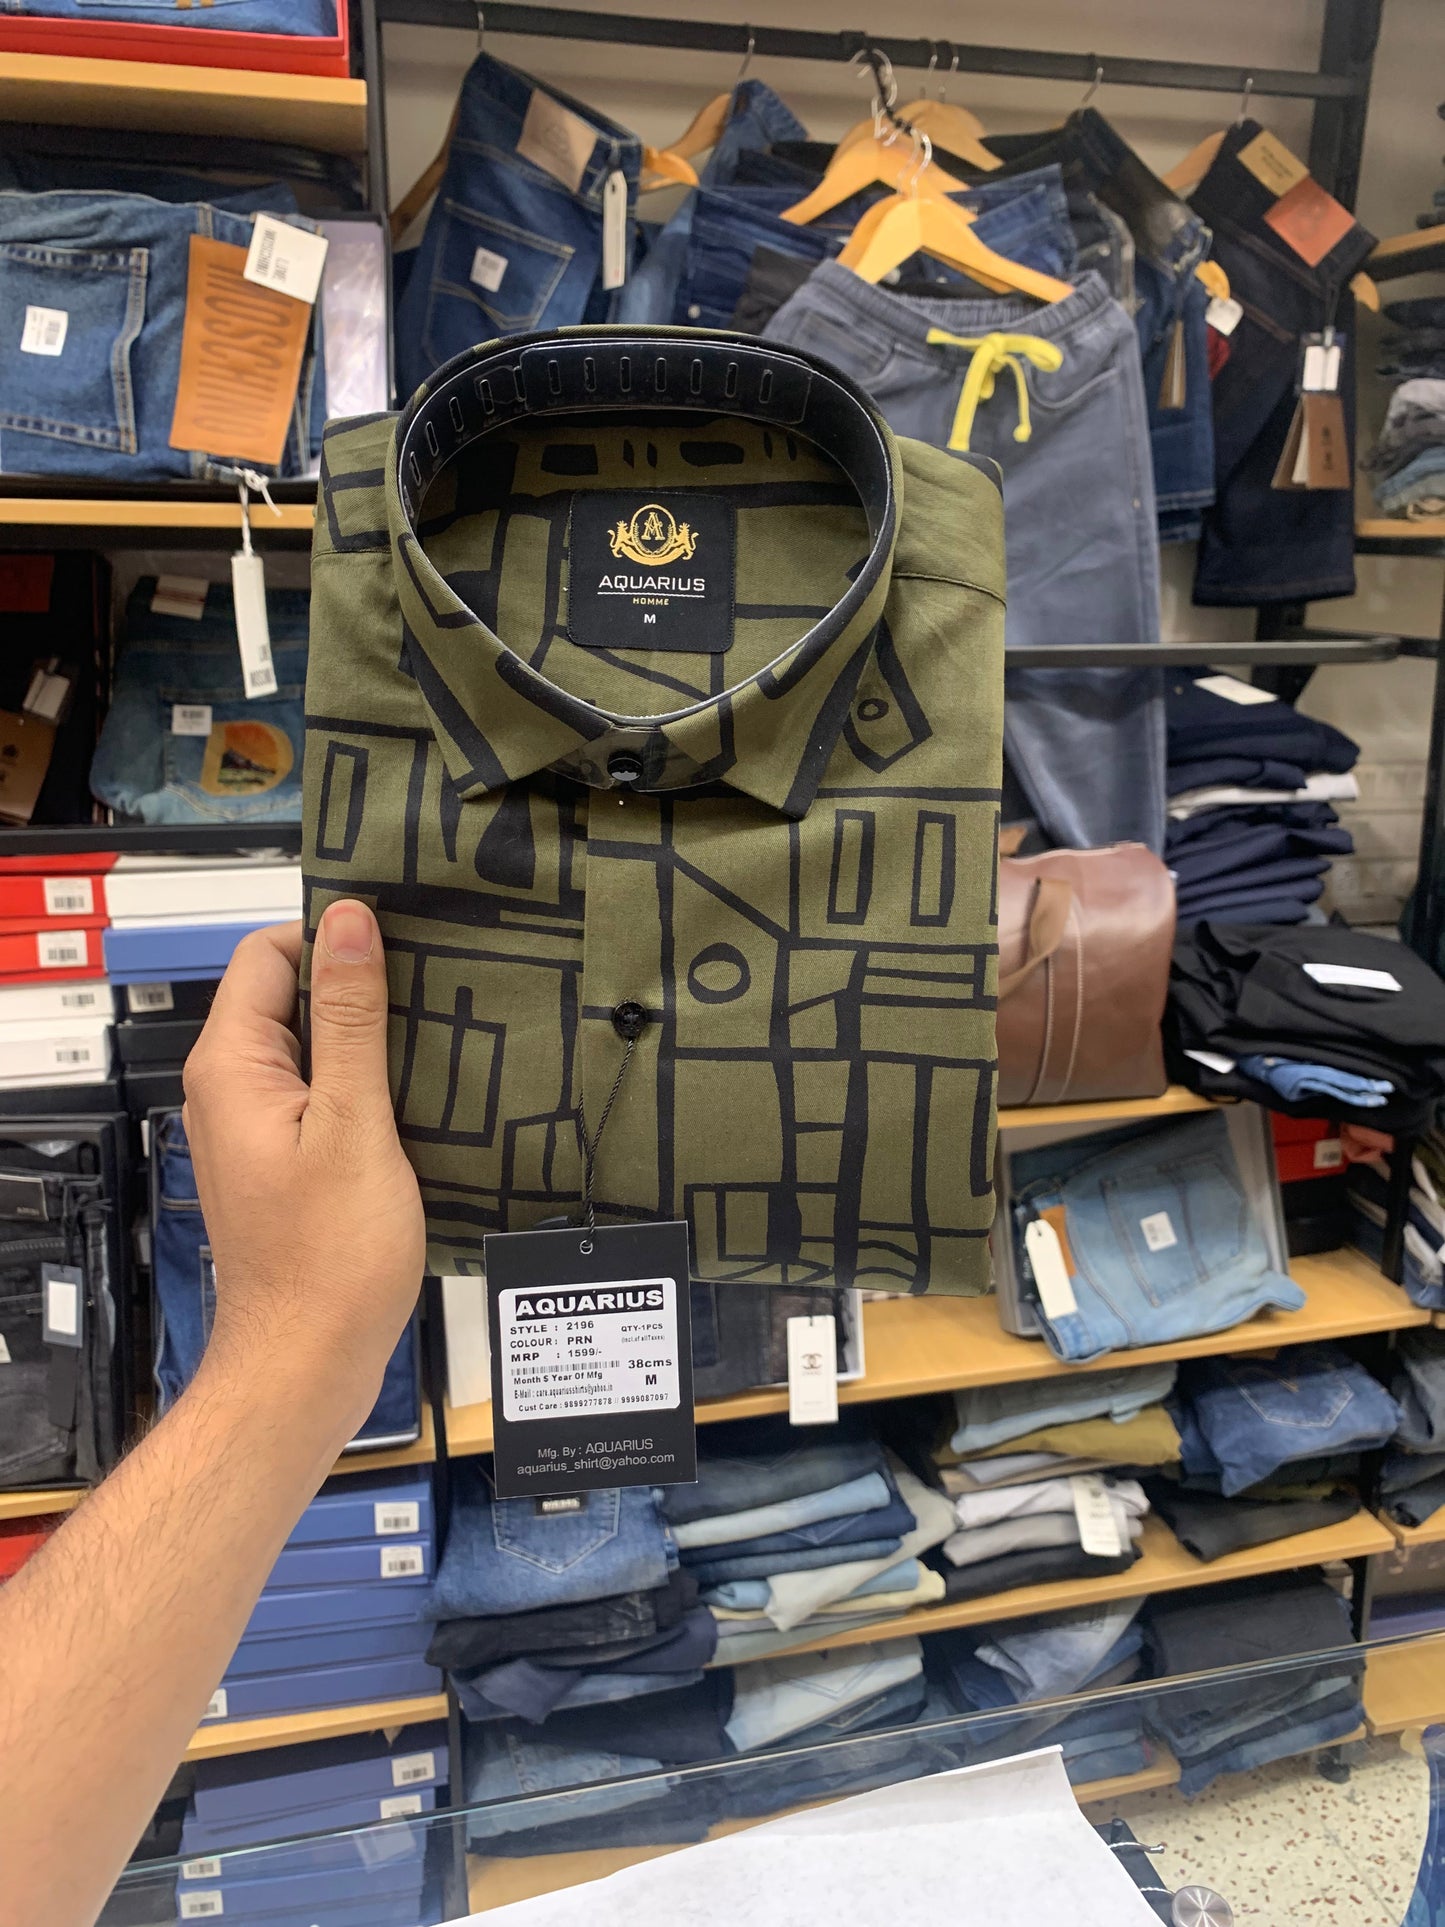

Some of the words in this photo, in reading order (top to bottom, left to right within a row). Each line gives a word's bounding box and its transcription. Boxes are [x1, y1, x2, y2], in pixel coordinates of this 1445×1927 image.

[598, 575, 706, 592] AQUARIUS
[632, 597, 670, 606] HOMME
[643, 613, 656, 624] M
[515, 1289, 664, 1317] AQUARIUS
[510, 1324, 548, 1335] STYLE
[566, 1320, 594, 1330] 2196
[621, 1323, 664, 1332] QTY-1PCS
[567, 1335, 593, 1345] PRN
[511, 1352, 540, 1362] MRP
[568, 1347, 602, 1358] 1599/-
[628, 1358, 672, 1369] 38cms
[513, 1376, 541, 1385] Month
[552, 1374, 572, 1382] Year
[574, 1372, 584, 1380] Of
[586, 1371, 603, 1380] Mfg
[645, 1373, 657, 1386] M
[518, 1404, 537, 1412] Cust
[539, 1403, 558, 1411] Care
[537, 1448, 560, 1459] Mfg.
[562, 1446, 576, 1458] By
[585, 1438, 654, 1454] AQUARIUS
[516, 1453, 675, 1475] aquarius_shirt@yahoo.com
